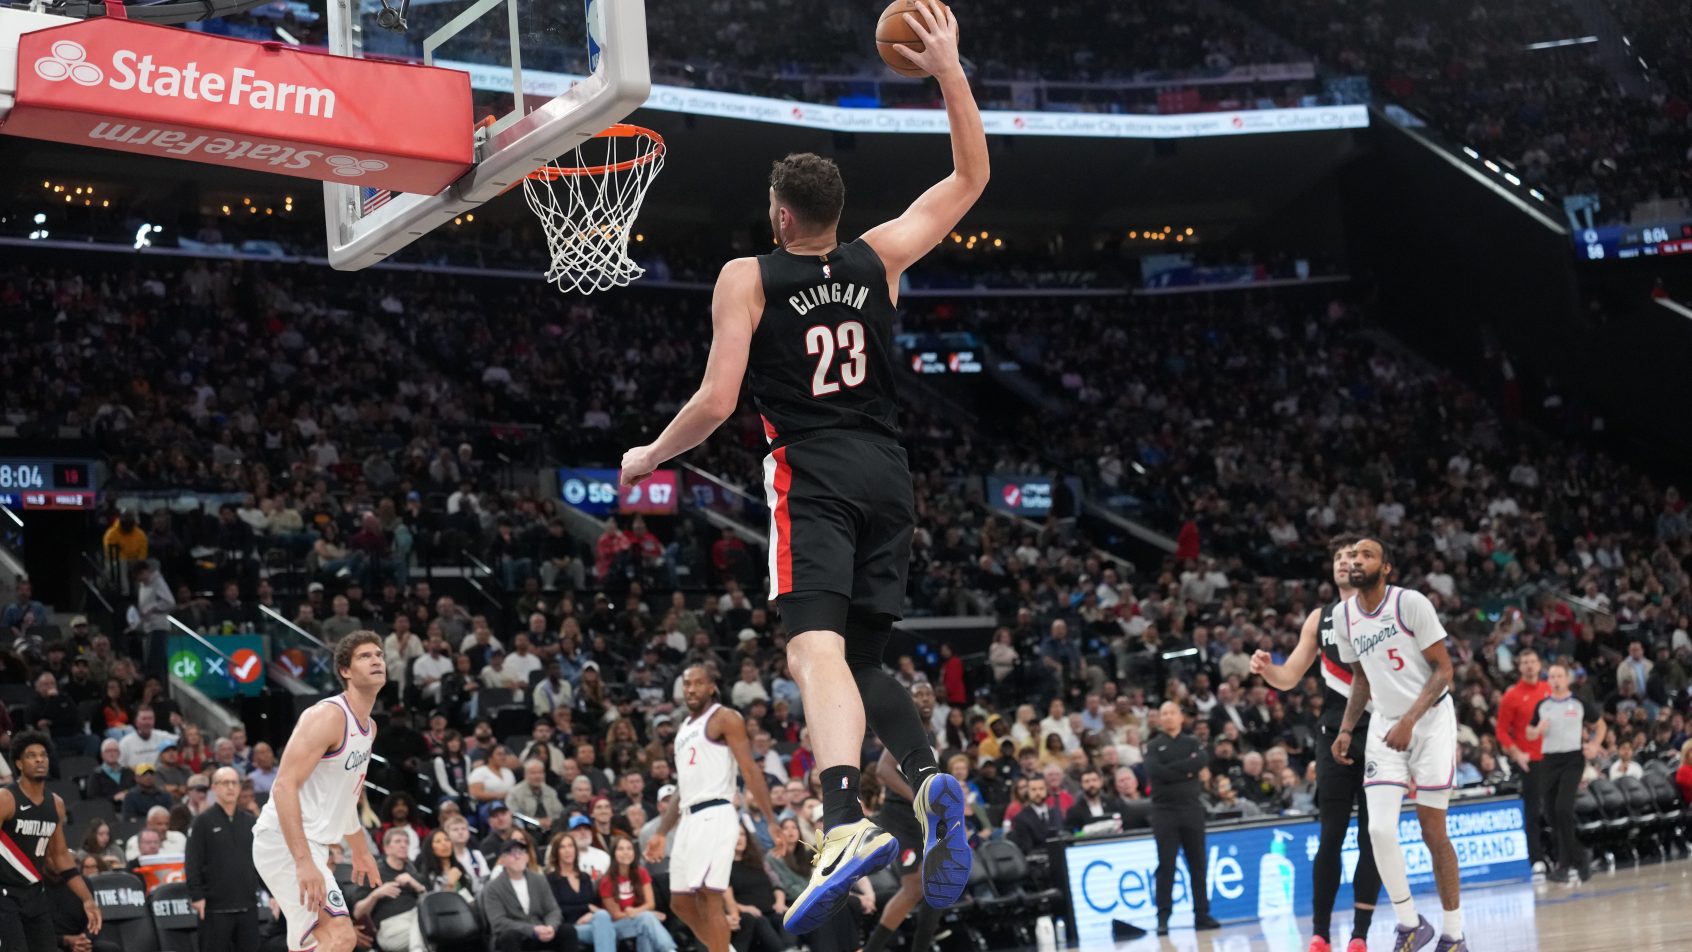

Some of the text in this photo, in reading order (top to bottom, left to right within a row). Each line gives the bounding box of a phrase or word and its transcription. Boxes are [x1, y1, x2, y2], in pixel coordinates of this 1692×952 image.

[688, 97, 717, 109] store
[720, 102, 746, 112] now
[750, 105, 780, 119] open
[833, 112, 872, 126] Culver
[876, 114, 900, 131] City
[905, 117, 934, 128] store
[1057, 117, 1095, 130] Culver
[1098, 119, 1121, 136] City
[1277, 113, 1316, 127] Culver
[1320, 111, 1344, 128] City
[788, 282, 869, 316] CLINGAN
[805, 320, 867, 397] 23
[0, 465, 43, 488] 8:04
[1353, 623, 1398, 657] Clippers
[173, 656, 197, 677] ck
[1387, 648, 1405, 672] 5
[688, 746, 697, 766] 2
[1445, 807, 1524, 838] ECOMMENDED
[1457, 836, 1516, 862] BRAND
[99, 889, 119, 906] THE
[152, 899, 190, 916] GET THE
